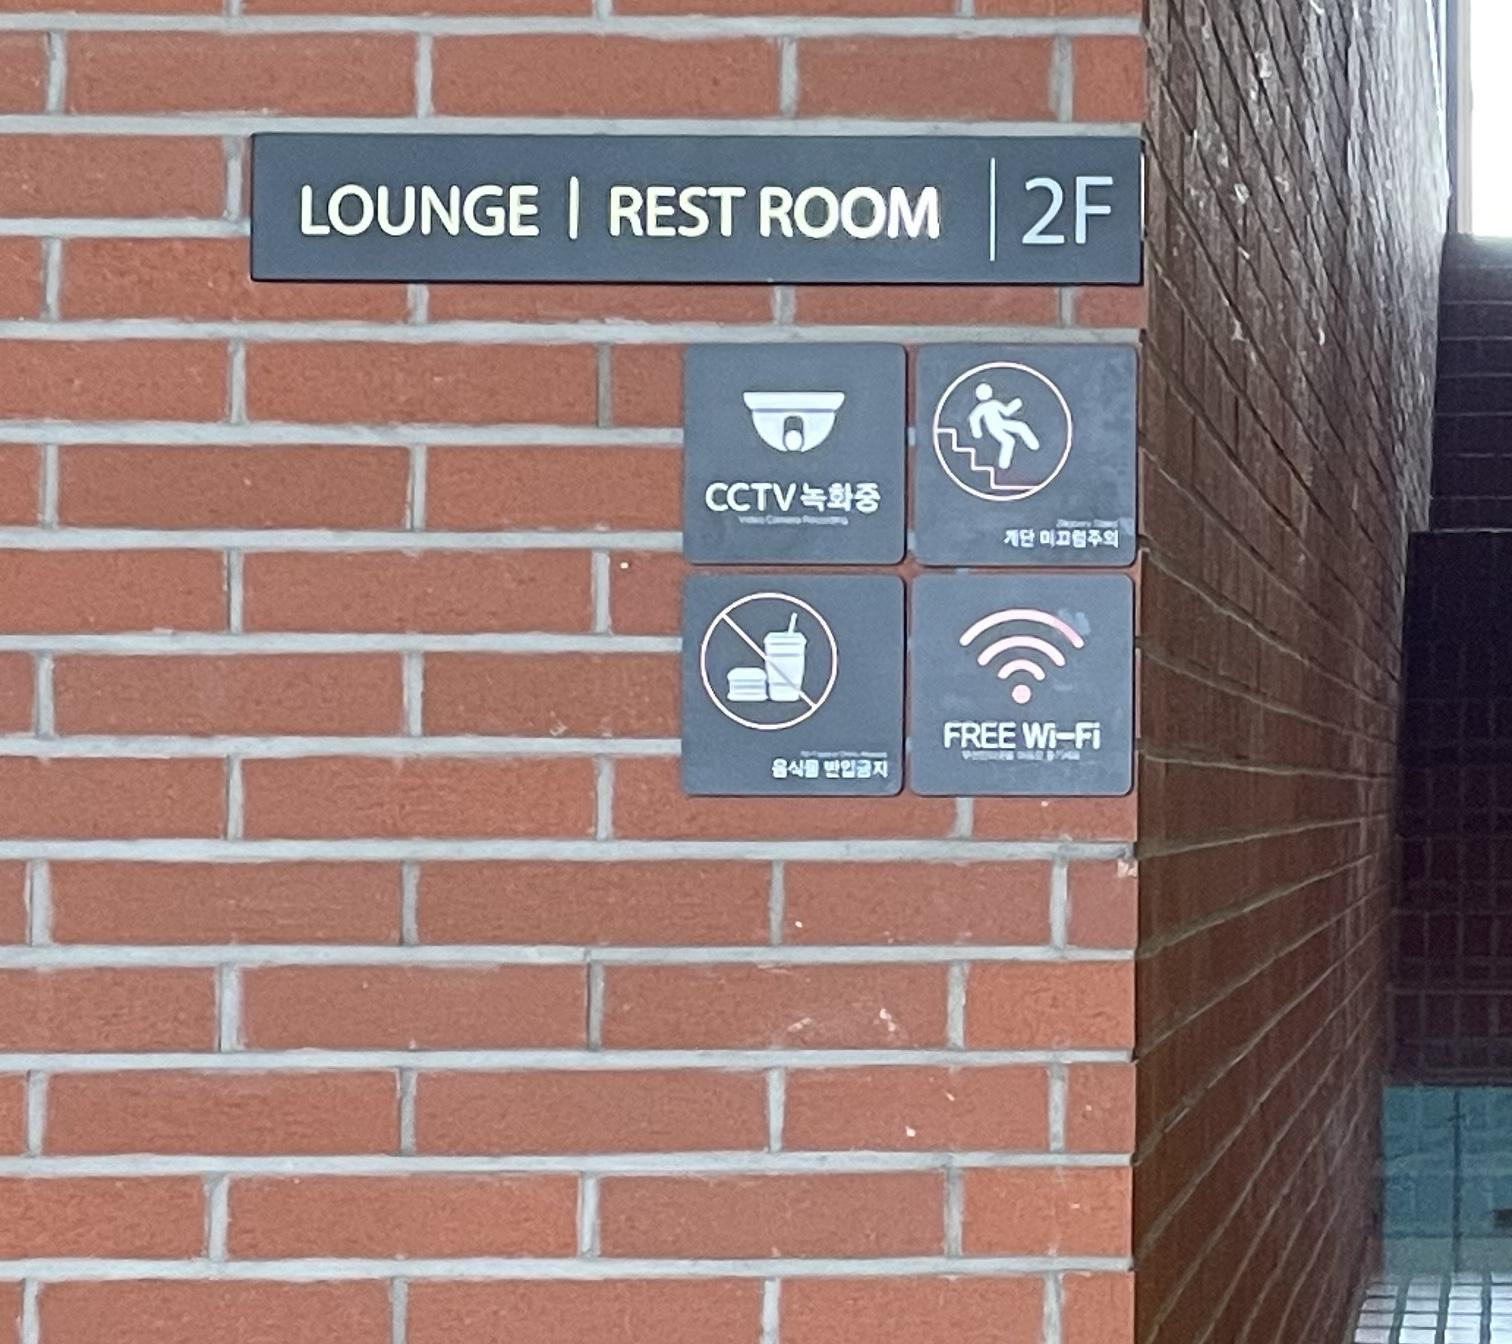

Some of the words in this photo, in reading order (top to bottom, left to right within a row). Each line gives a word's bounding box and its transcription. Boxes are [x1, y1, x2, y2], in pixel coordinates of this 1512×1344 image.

[301, 184, 540, 237] LOUNGE
[610, 186, 747, 238] REST
[759, 186, 941, 240] ROOM
[1021, 176, 1115, 245] 2F
[705, 482, 797, 512] CCTV
[800, 482, 881, 513] 녹화중
[1003, 528, 1035, 548] 계단
[944, 721, 1017, 749] FREE
[1022, 721, 1100, 749] Wi-Fi
[823, 759, 888, 778] 반입금지
